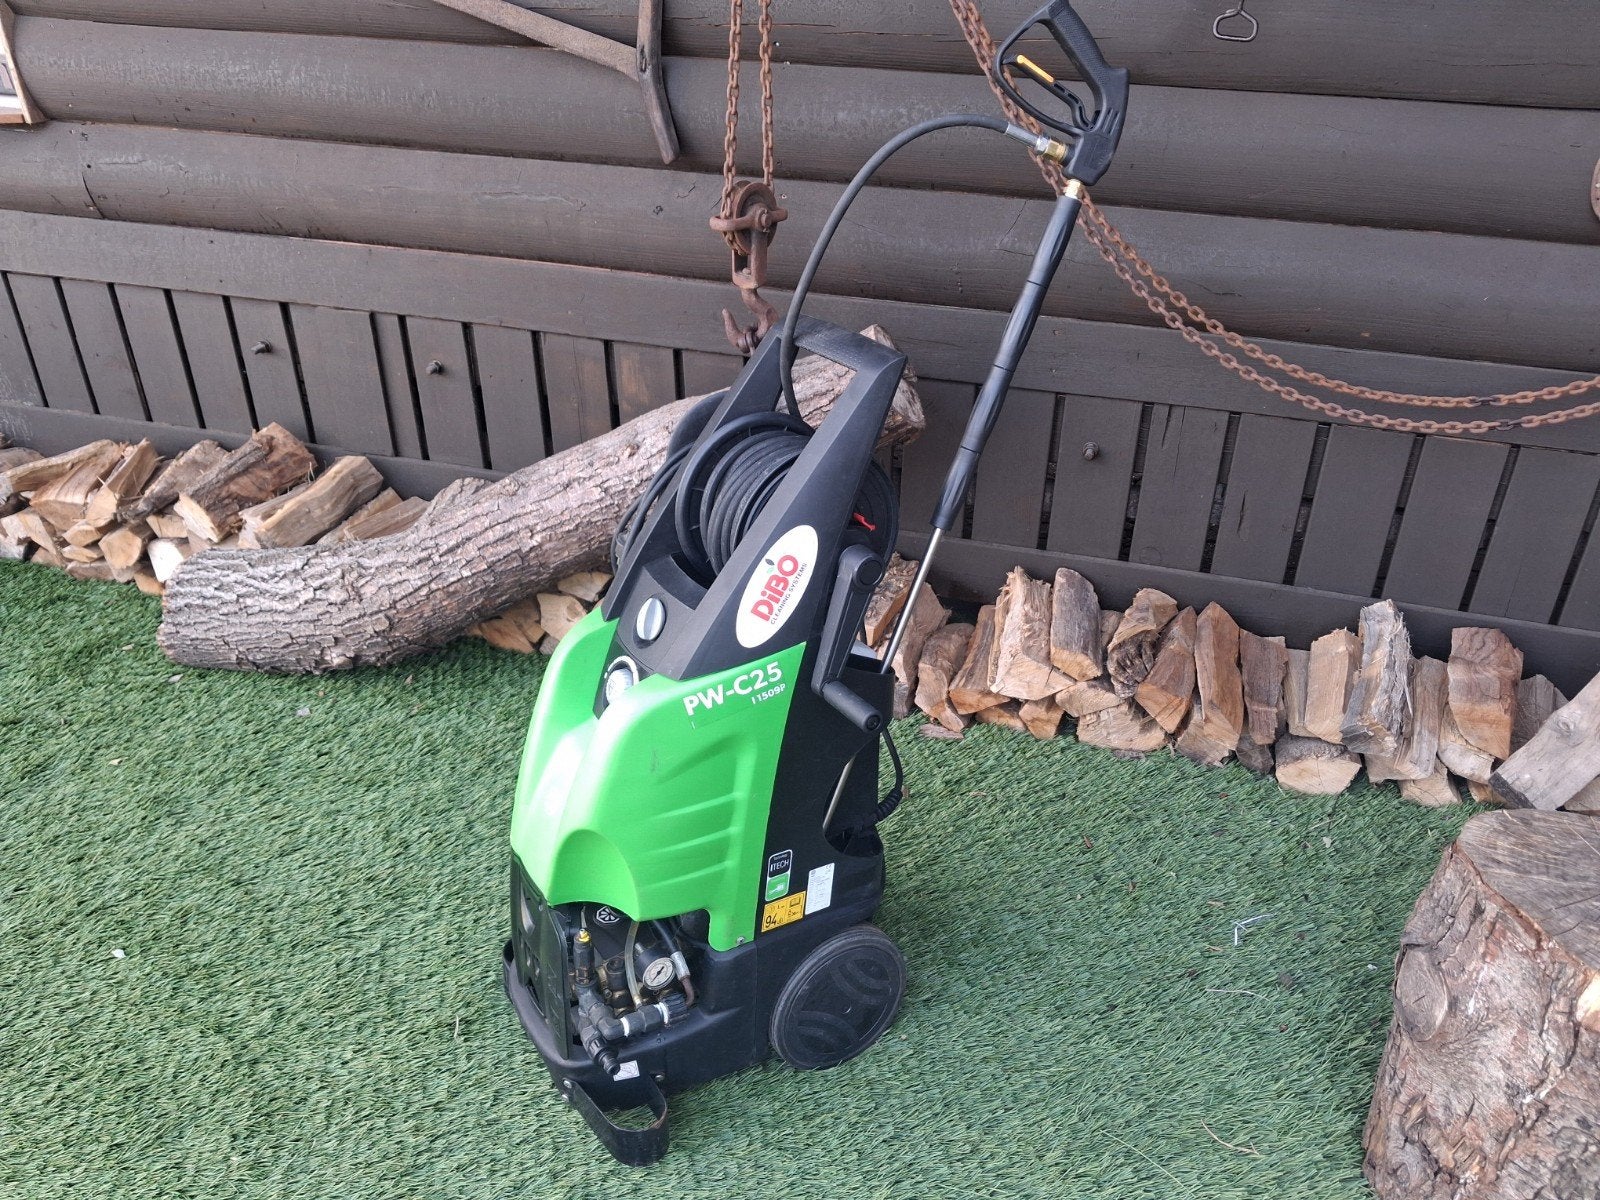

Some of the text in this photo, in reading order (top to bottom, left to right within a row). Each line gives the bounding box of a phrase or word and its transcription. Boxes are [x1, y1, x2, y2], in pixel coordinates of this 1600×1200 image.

[770, 563, 807, 625] CLEANING SYSTEMS
[683, 662, 782, 716] PW-C25
[770, 860, 789, 872] ITECH
[765, 913, 777, 928] 94
